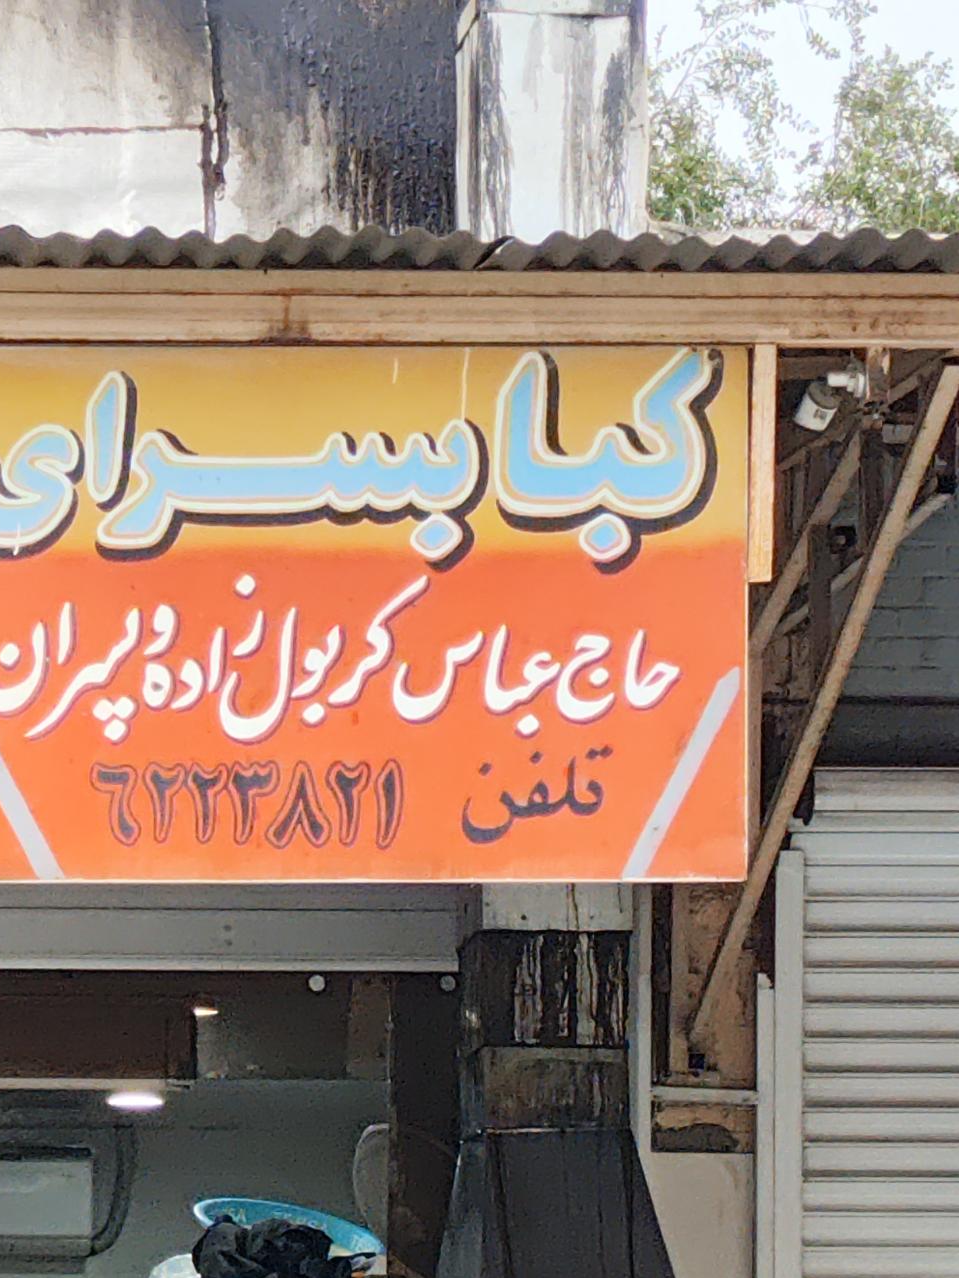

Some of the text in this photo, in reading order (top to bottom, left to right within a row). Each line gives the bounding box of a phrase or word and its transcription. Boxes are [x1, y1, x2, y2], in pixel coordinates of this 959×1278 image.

[392, 623, 561, 738] عباس
[556, 628, 681, 725] حاج
[460, 745, 615, 845] تلفن
